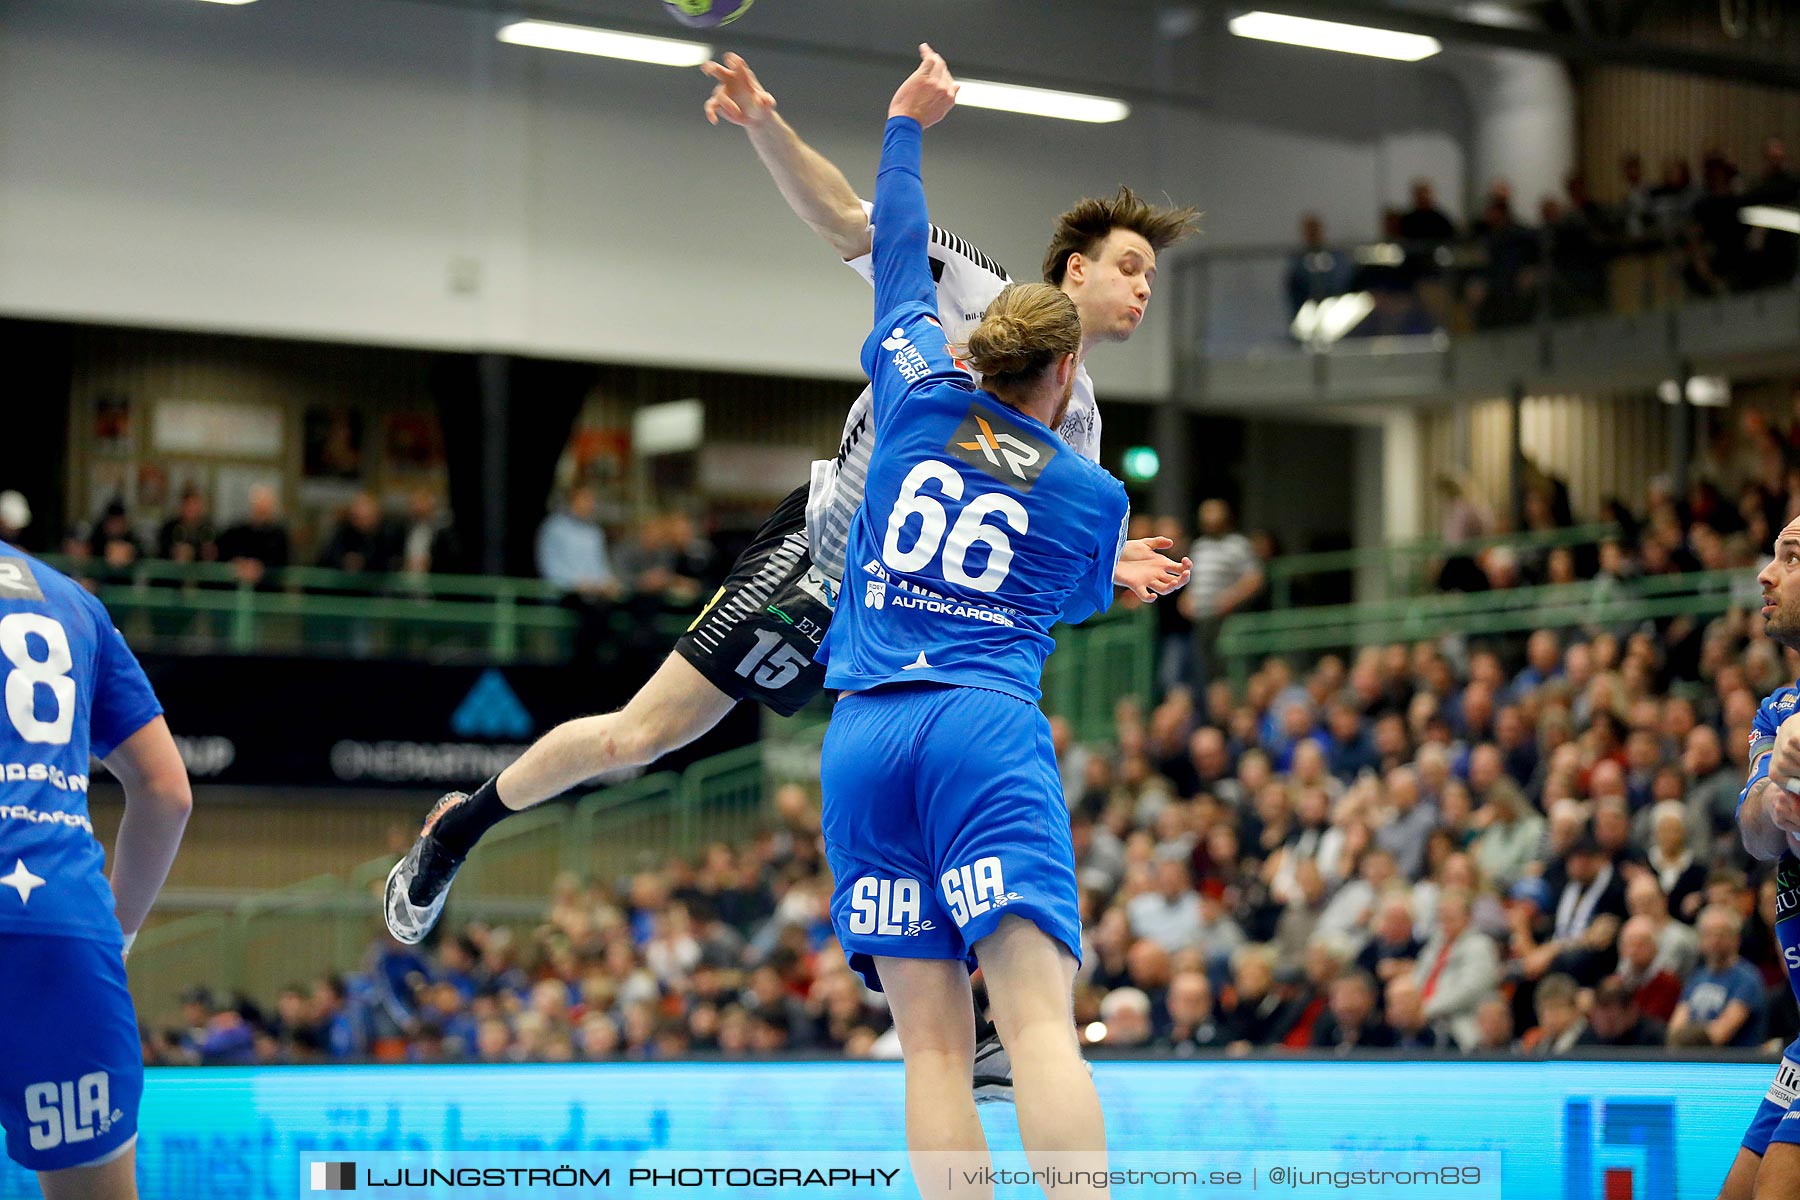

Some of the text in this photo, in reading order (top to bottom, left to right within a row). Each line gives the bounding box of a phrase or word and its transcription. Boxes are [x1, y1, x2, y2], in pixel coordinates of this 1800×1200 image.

[892, 351, 921, 385] SPORT
[902, 344, 933, 380] INTER
[883, 460, 1029, 593] 66
[0, 612, 76, 745] 8
[735, 628, 811, 689] 15
